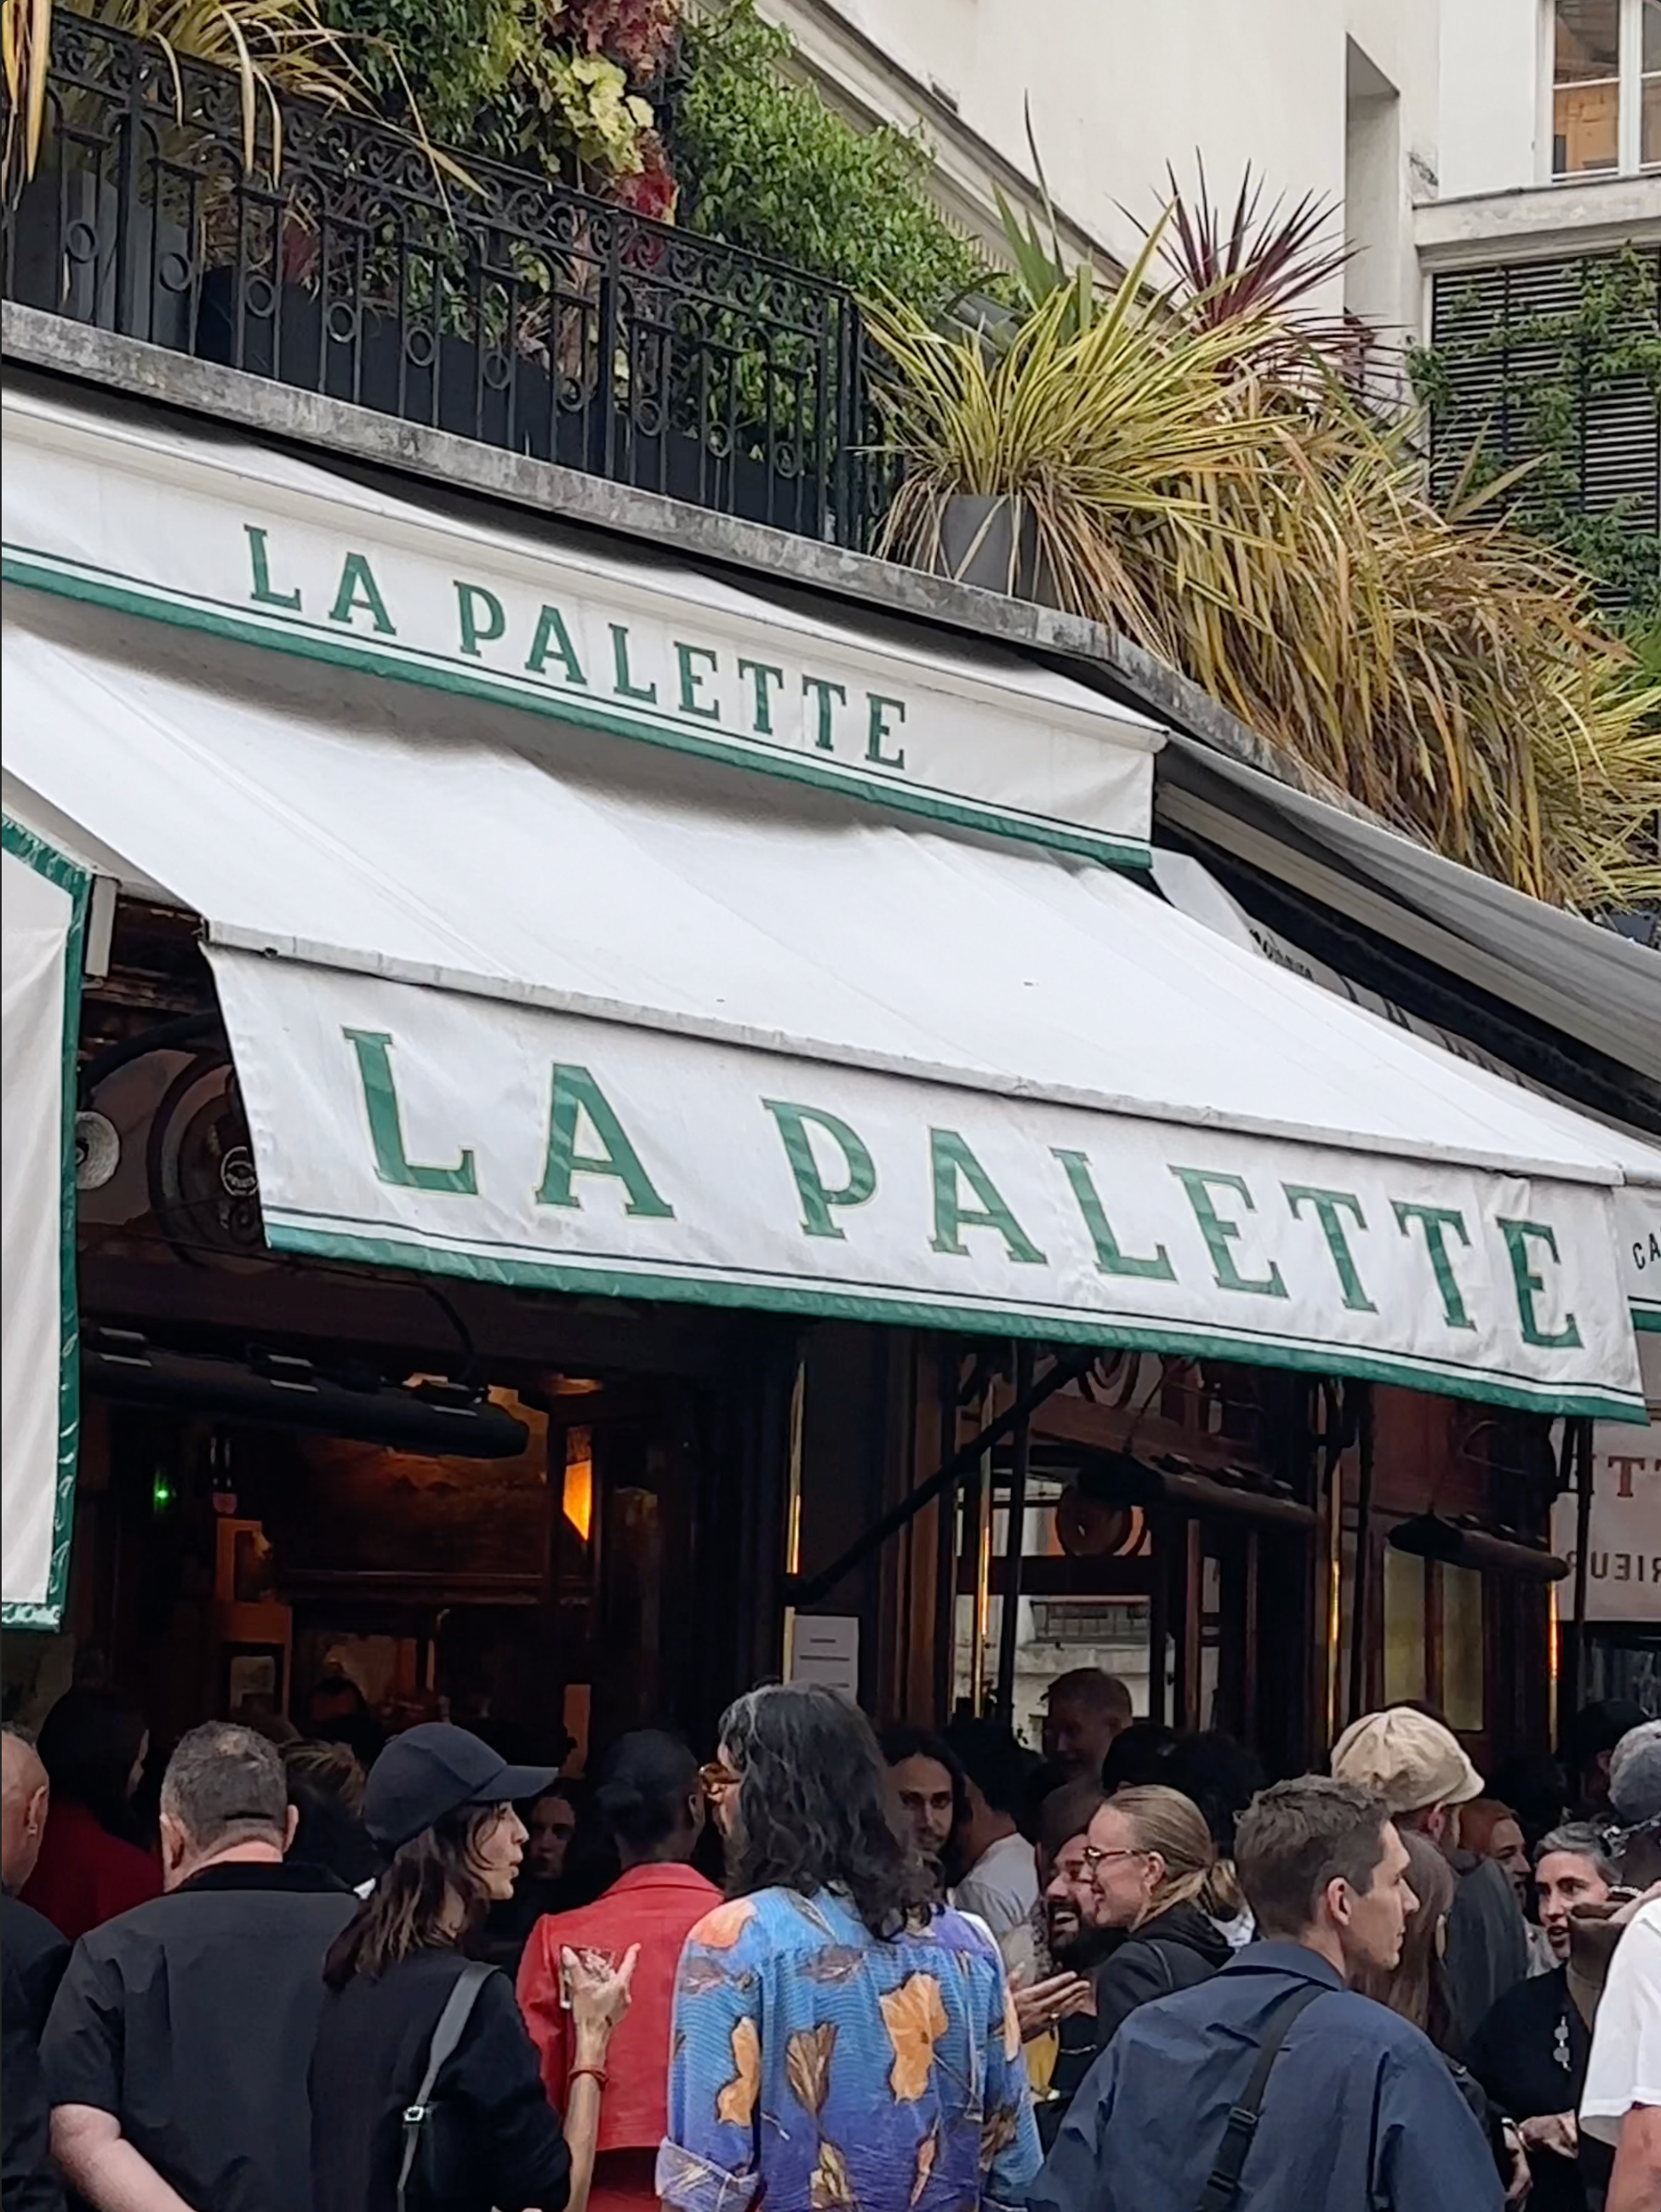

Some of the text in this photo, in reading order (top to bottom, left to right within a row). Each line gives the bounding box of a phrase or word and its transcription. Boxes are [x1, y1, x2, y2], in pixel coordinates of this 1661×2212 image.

[243, 524, 907, 772] LA PALETTE
[341, 1025, 1586, 1350] LA PALETTE
[1632, 1225, 1661, 1270] CA
